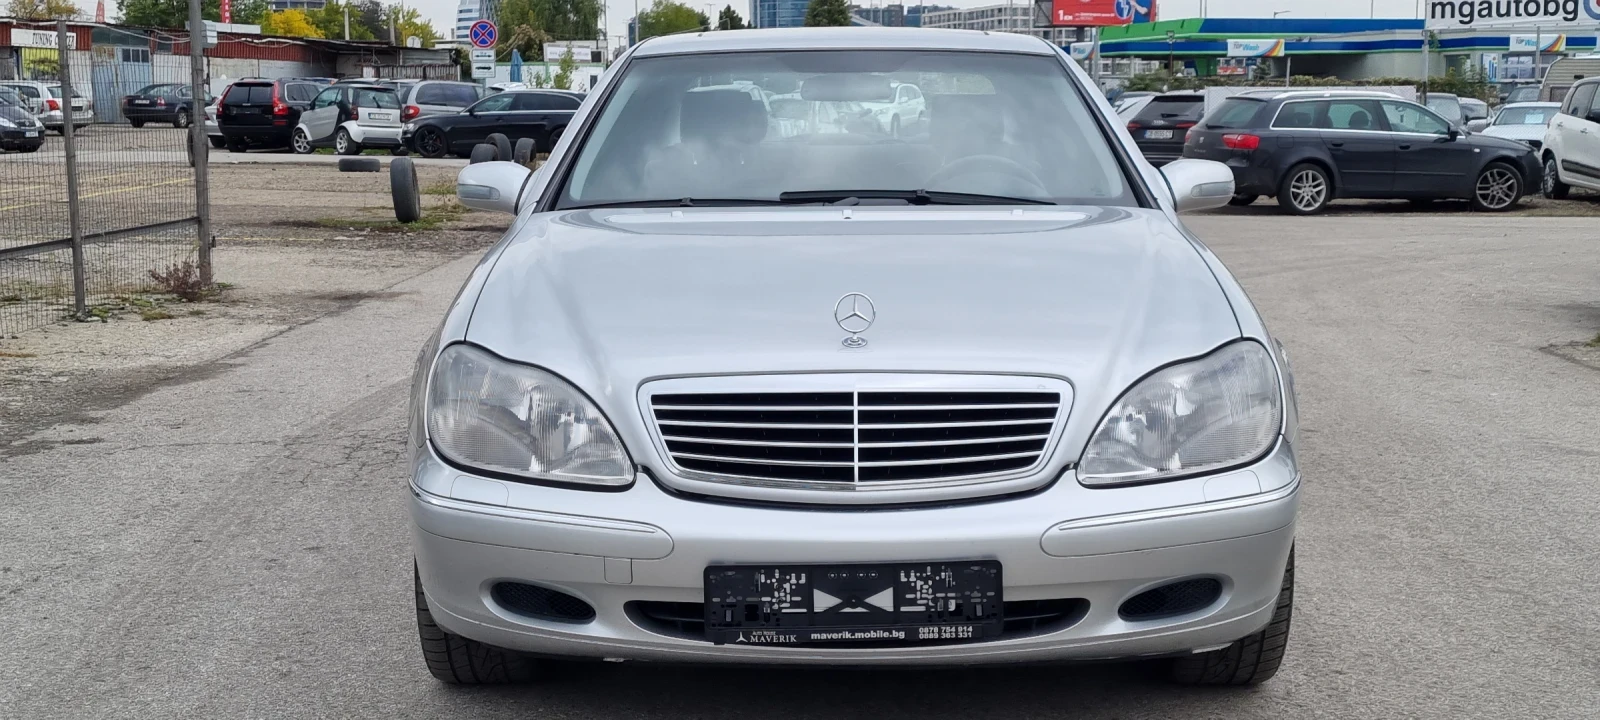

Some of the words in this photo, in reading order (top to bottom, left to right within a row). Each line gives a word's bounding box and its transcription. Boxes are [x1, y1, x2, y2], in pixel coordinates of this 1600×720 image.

[1431, 0, 1579, 24] mgautobg
[32, 33, 52, 46] TUNING
[811, 631, 905, 640] maverik.mobile.bg
